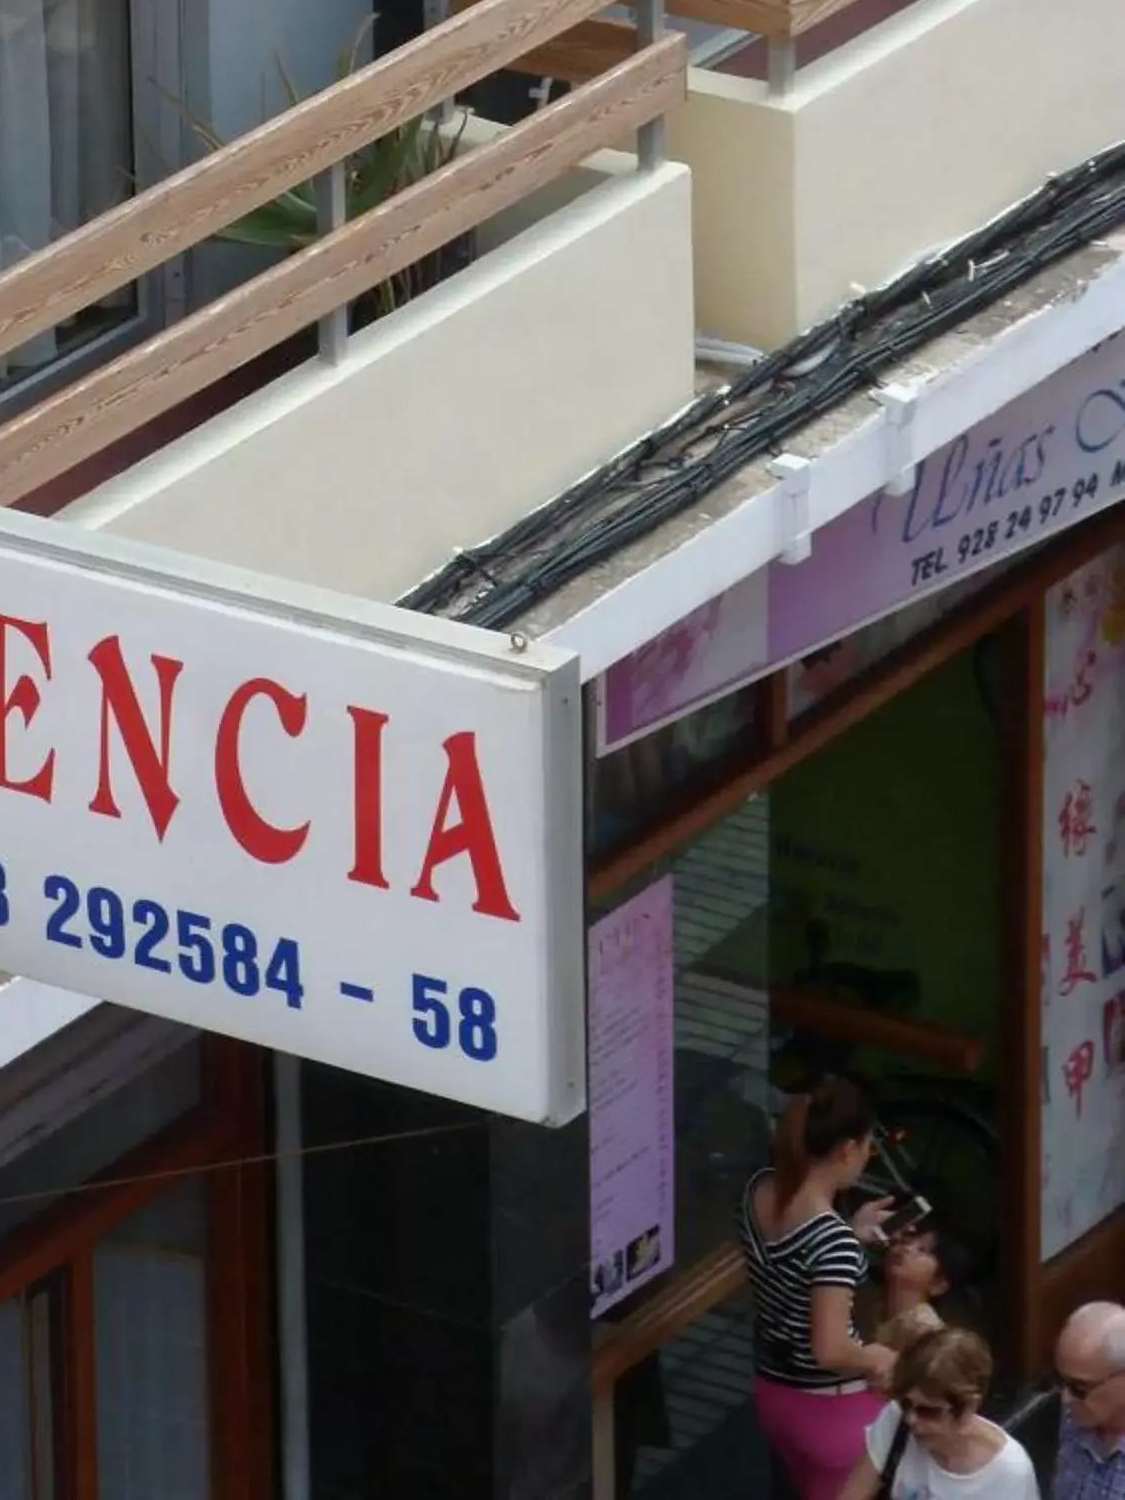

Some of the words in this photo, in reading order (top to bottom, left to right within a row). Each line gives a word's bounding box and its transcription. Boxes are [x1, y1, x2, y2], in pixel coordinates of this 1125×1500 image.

[911, 547, 948, 587] TEL
[957, 520, 999, 564] 928
[1004, 504, 1033, 540] 24
[1039, 487, 1067, 525] 97
[1072, 472, 1100, 508] 94
[43, 874, 305, 1010] 292584
[411, 974, 498, 1062] 58
